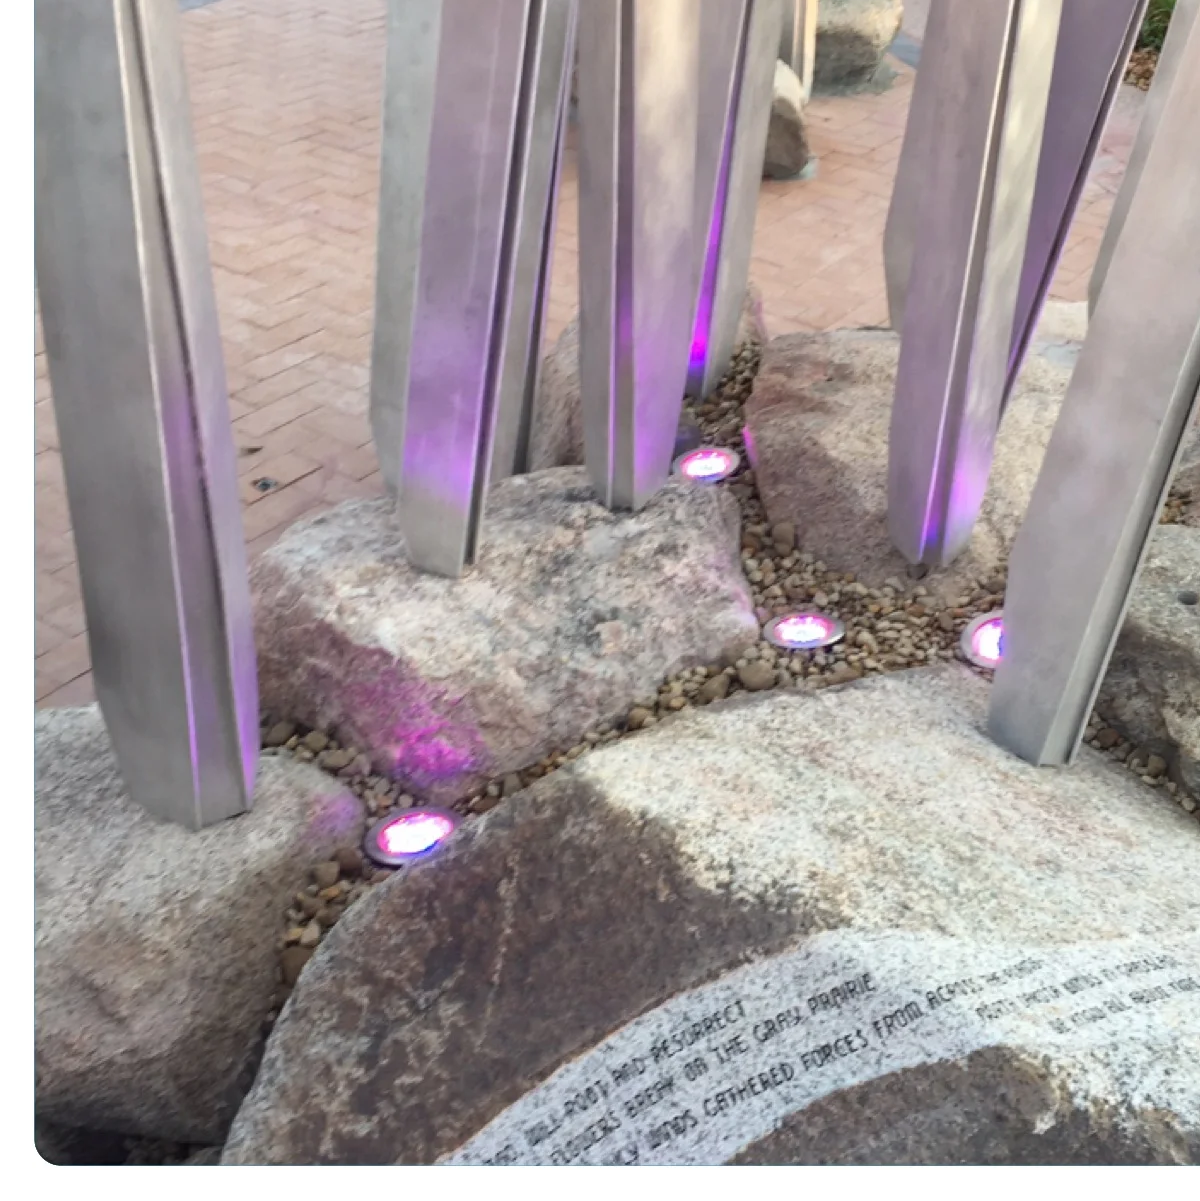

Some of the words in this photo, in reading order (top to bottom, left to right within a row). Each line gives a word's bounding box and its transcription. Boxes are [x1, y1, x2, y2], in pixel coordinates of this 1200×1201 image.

[650, 999, 747, 1064] RESURRECT
[703, 1062, 795, 1117] GATHERED
[801, 1029, 869, 1072] FORCES
[872, 1000, 924, 1040] FROM
[713, 1034, 749, 1065] THE
[752, 1005, 803, 1043] GRAY
[807, 972, 877, 1016] PRAIRIE
